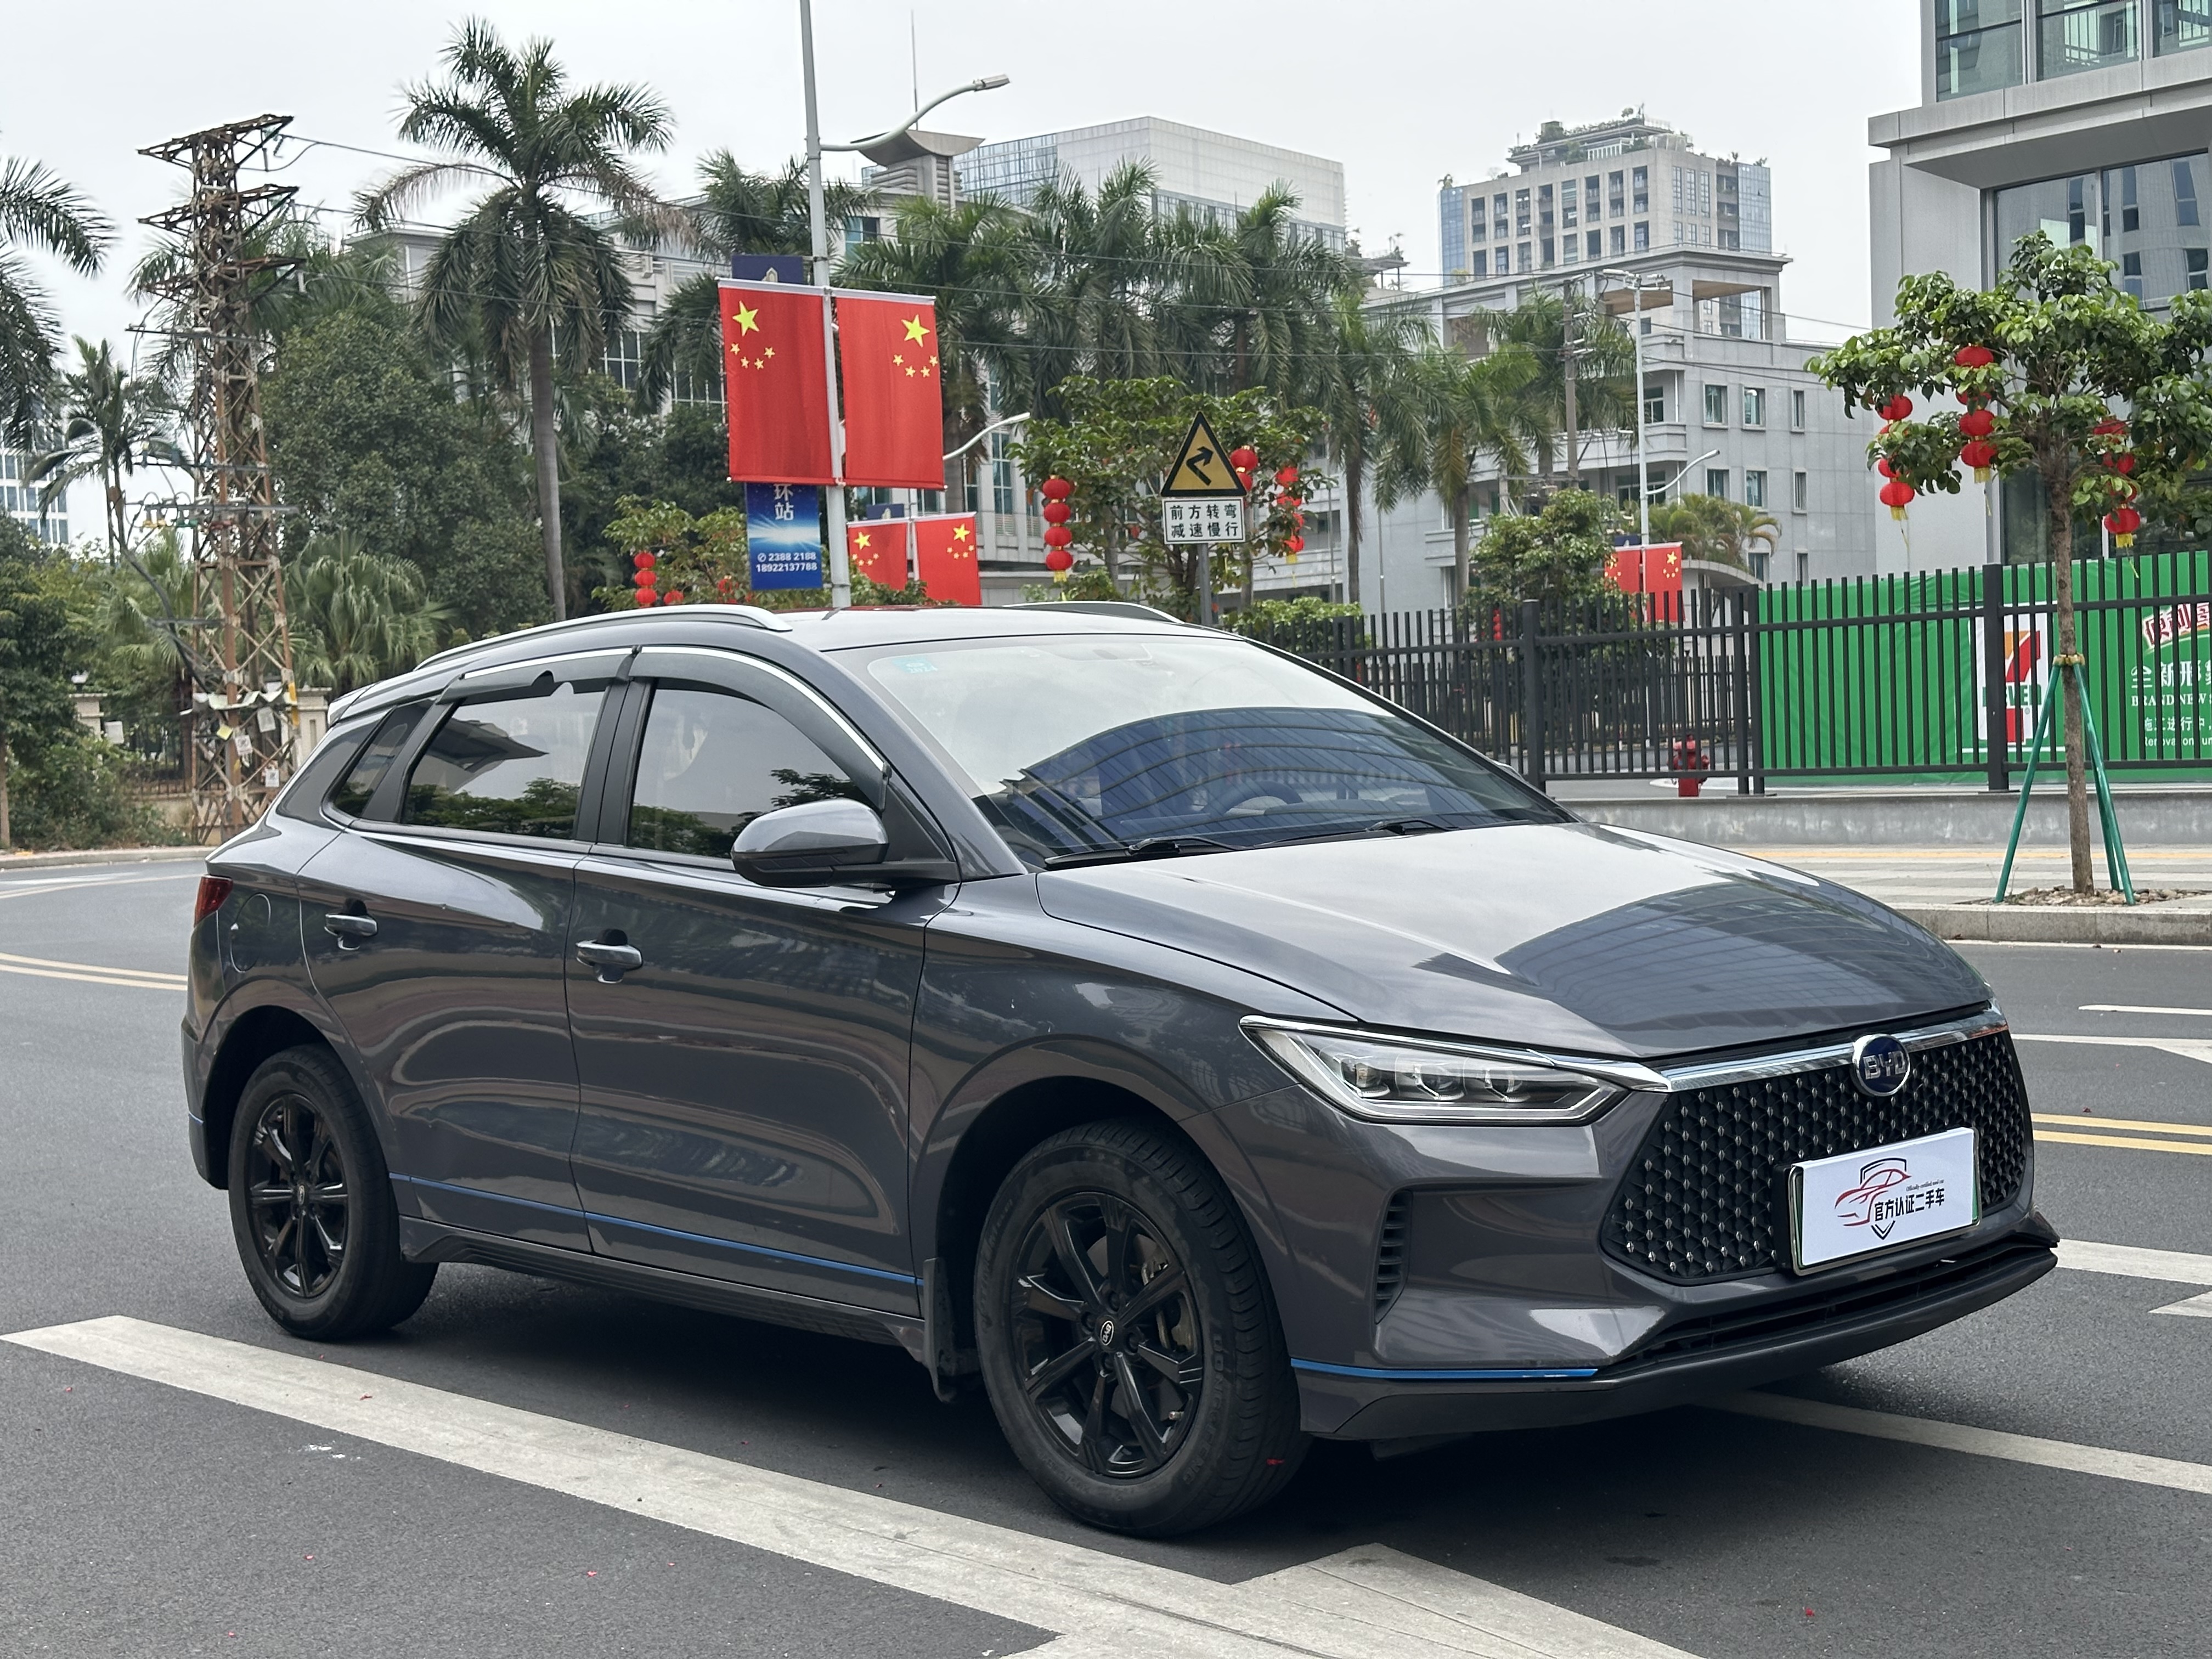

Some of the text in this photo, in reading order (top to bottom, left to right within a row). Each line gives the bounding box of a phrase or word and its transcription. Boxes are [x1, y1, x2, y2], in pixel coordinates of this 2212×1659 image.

[1170, 503, 1237, 520] 前方转弯
[1171, 522, 1238, 538] 减速慢行
[1863, 1051, 1906, 1080] BYD
[1874, 1187, 1945, 1222] 官方认证二手车
